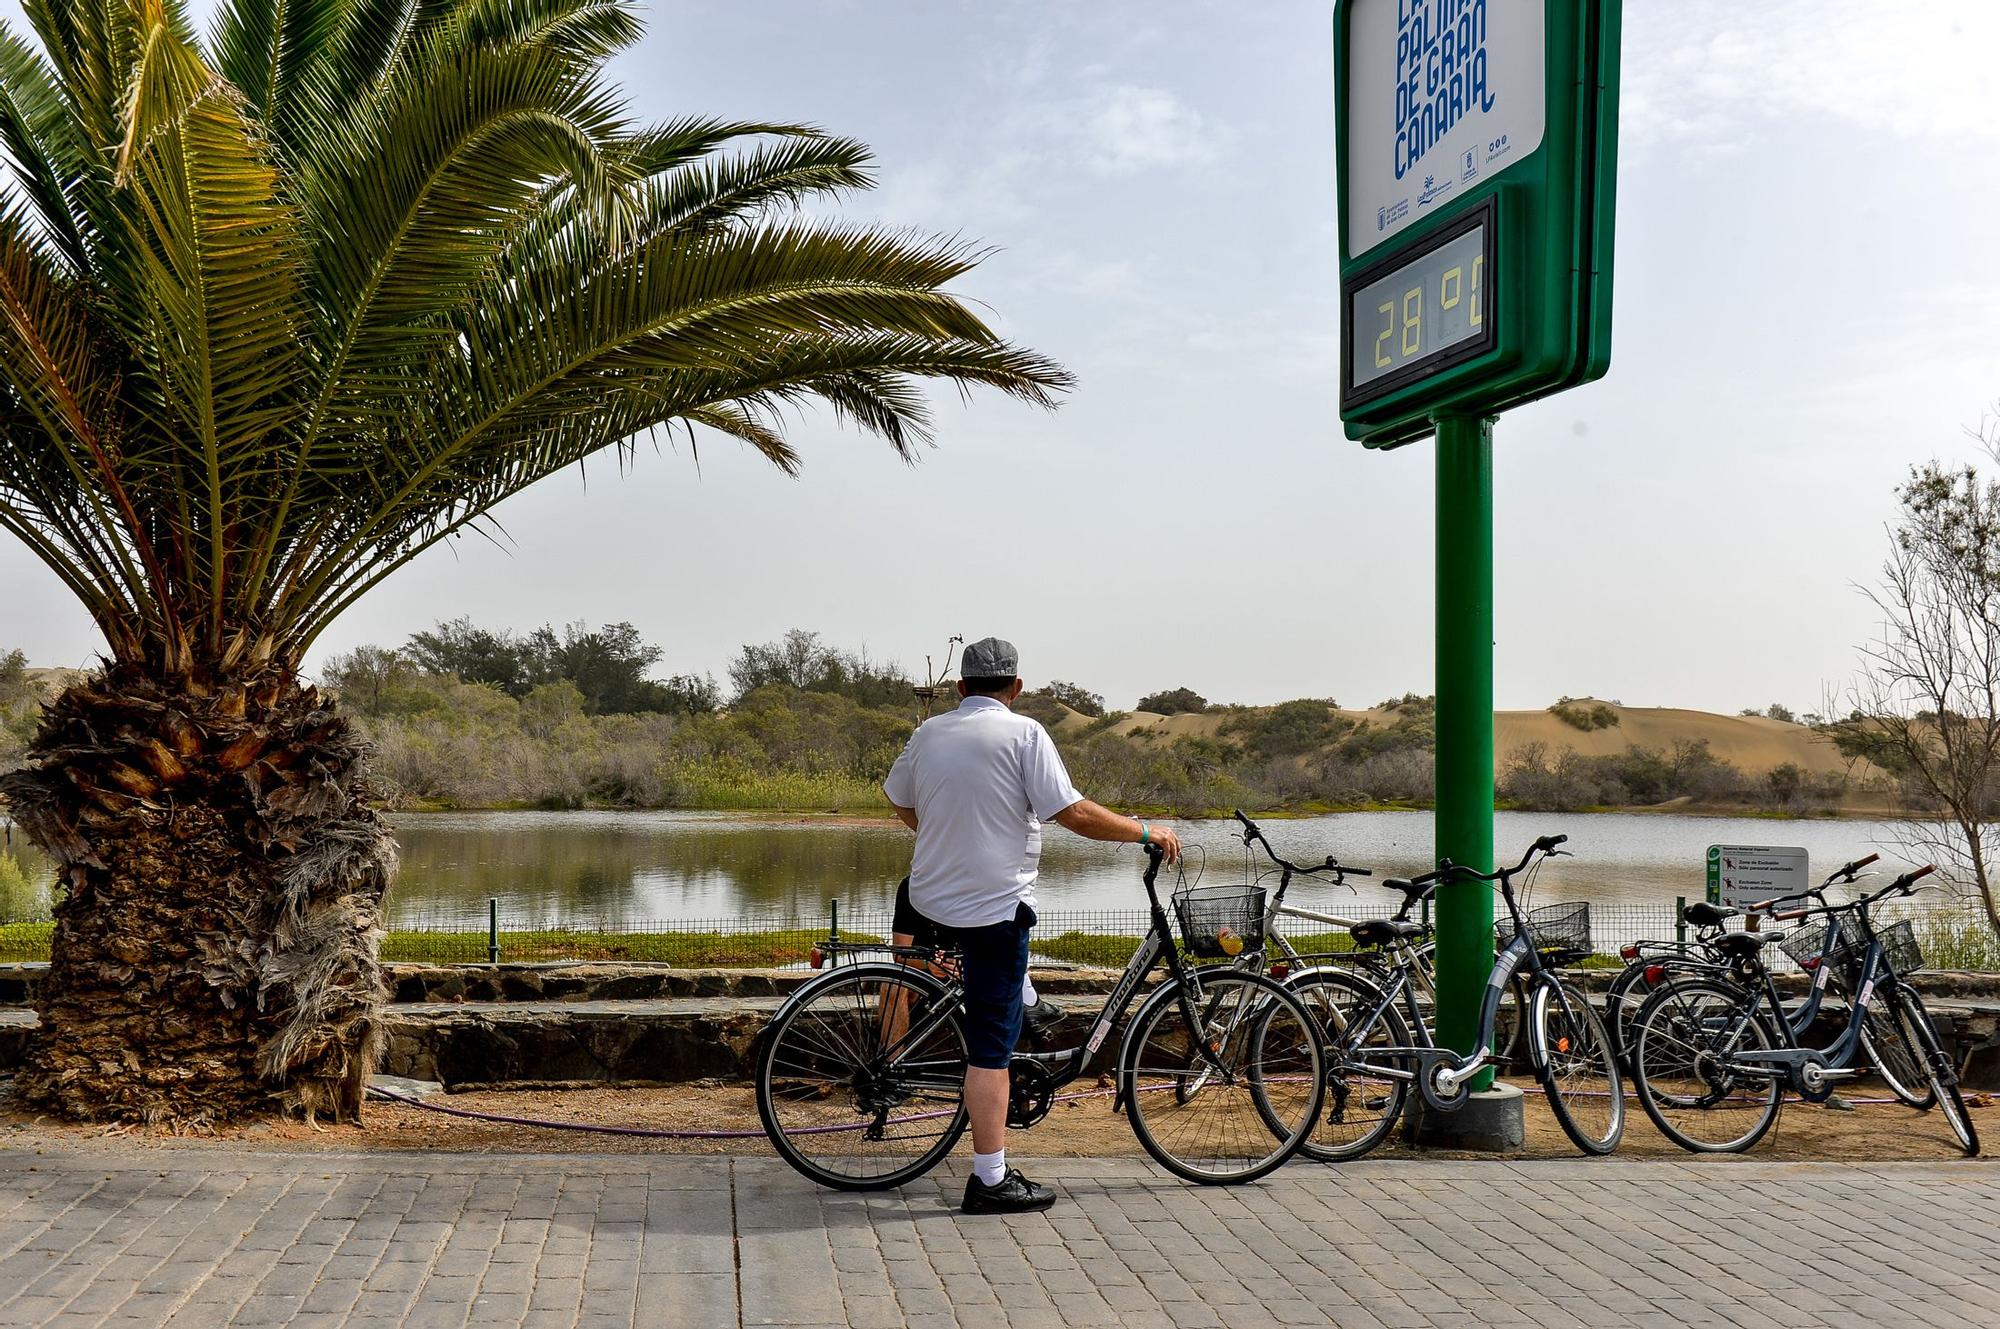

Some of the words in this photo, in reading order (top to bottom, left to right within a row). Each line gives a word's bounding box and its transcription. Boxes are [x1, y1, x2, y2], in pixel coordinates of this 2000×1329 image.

[1395, 47, 1496, 180] CANARIA
[1396, 63, 1421, 134] DE
[1427, 0, 1486, 97] GRAN
